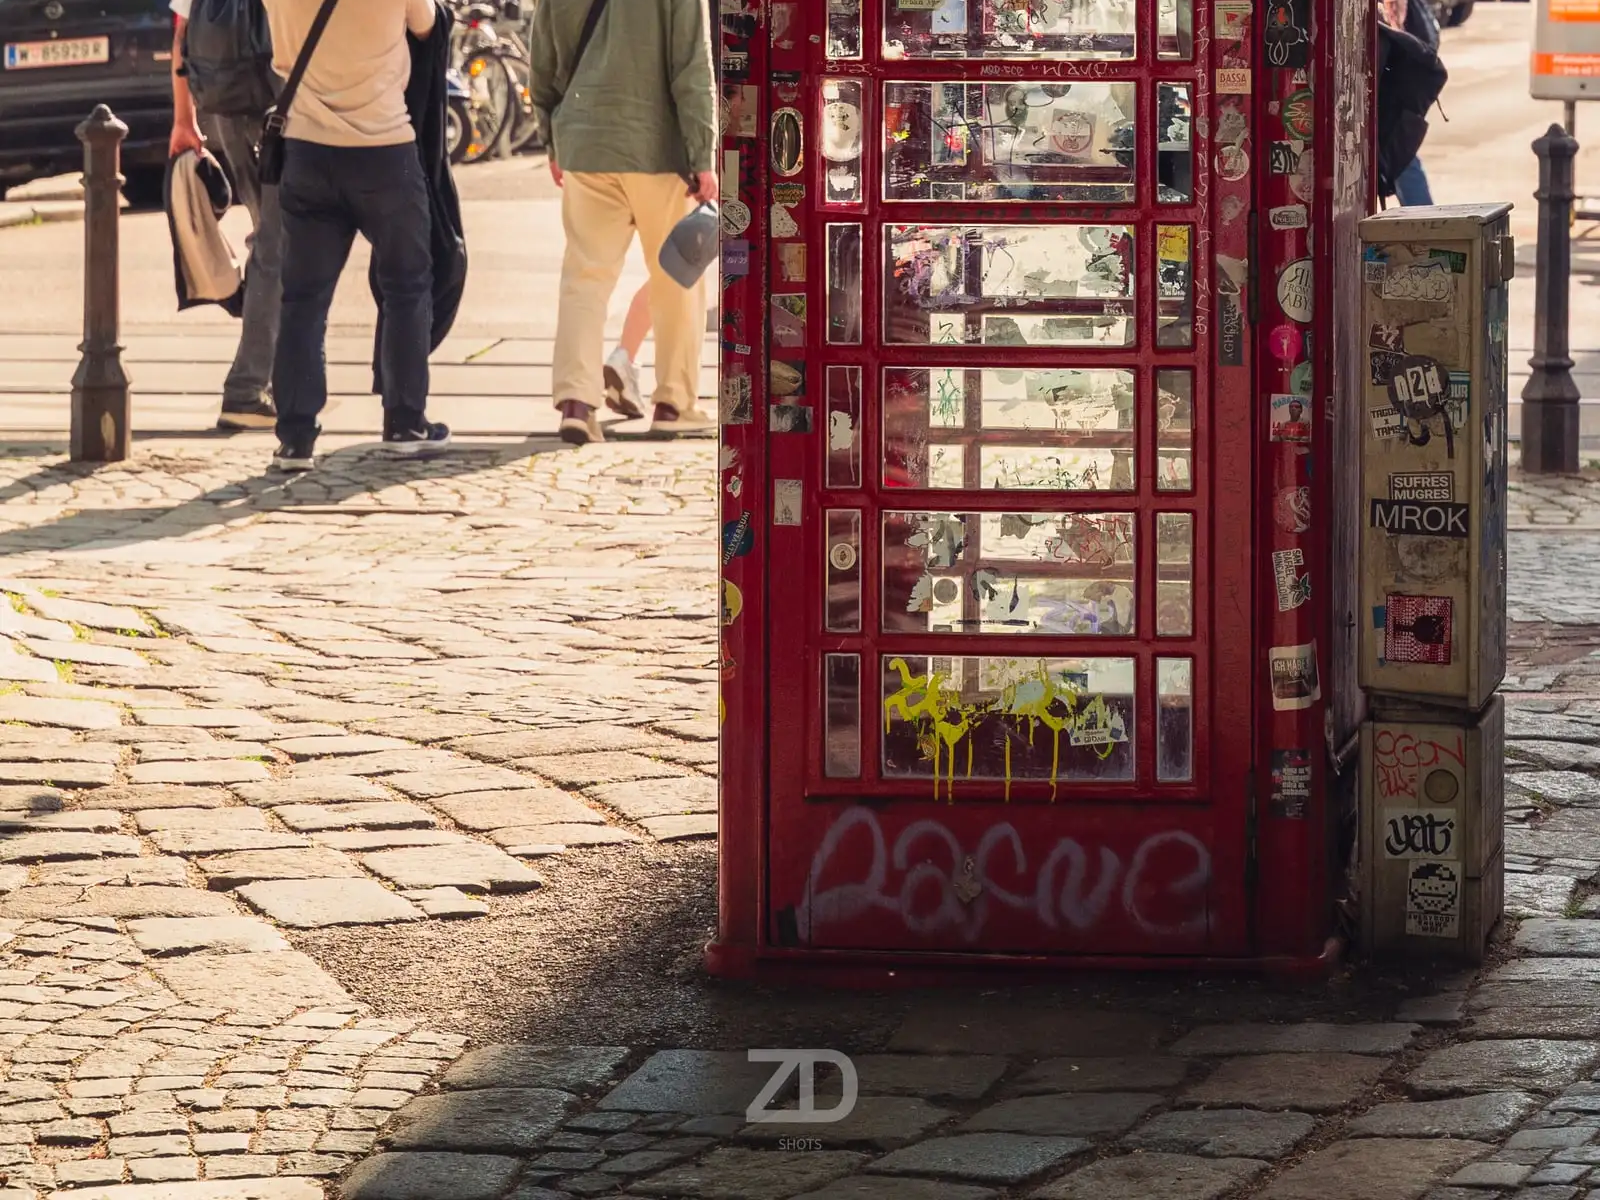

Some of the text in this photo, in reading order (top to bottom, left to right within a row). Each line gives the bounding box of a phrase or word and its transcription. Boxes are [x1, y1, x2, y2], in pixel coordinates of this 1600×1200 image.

[1394, 476, 1449, 489] SUFRES
[1394, 489, 1450, 500] MUGRES
[1375, 503, 1467, 533] MROK
